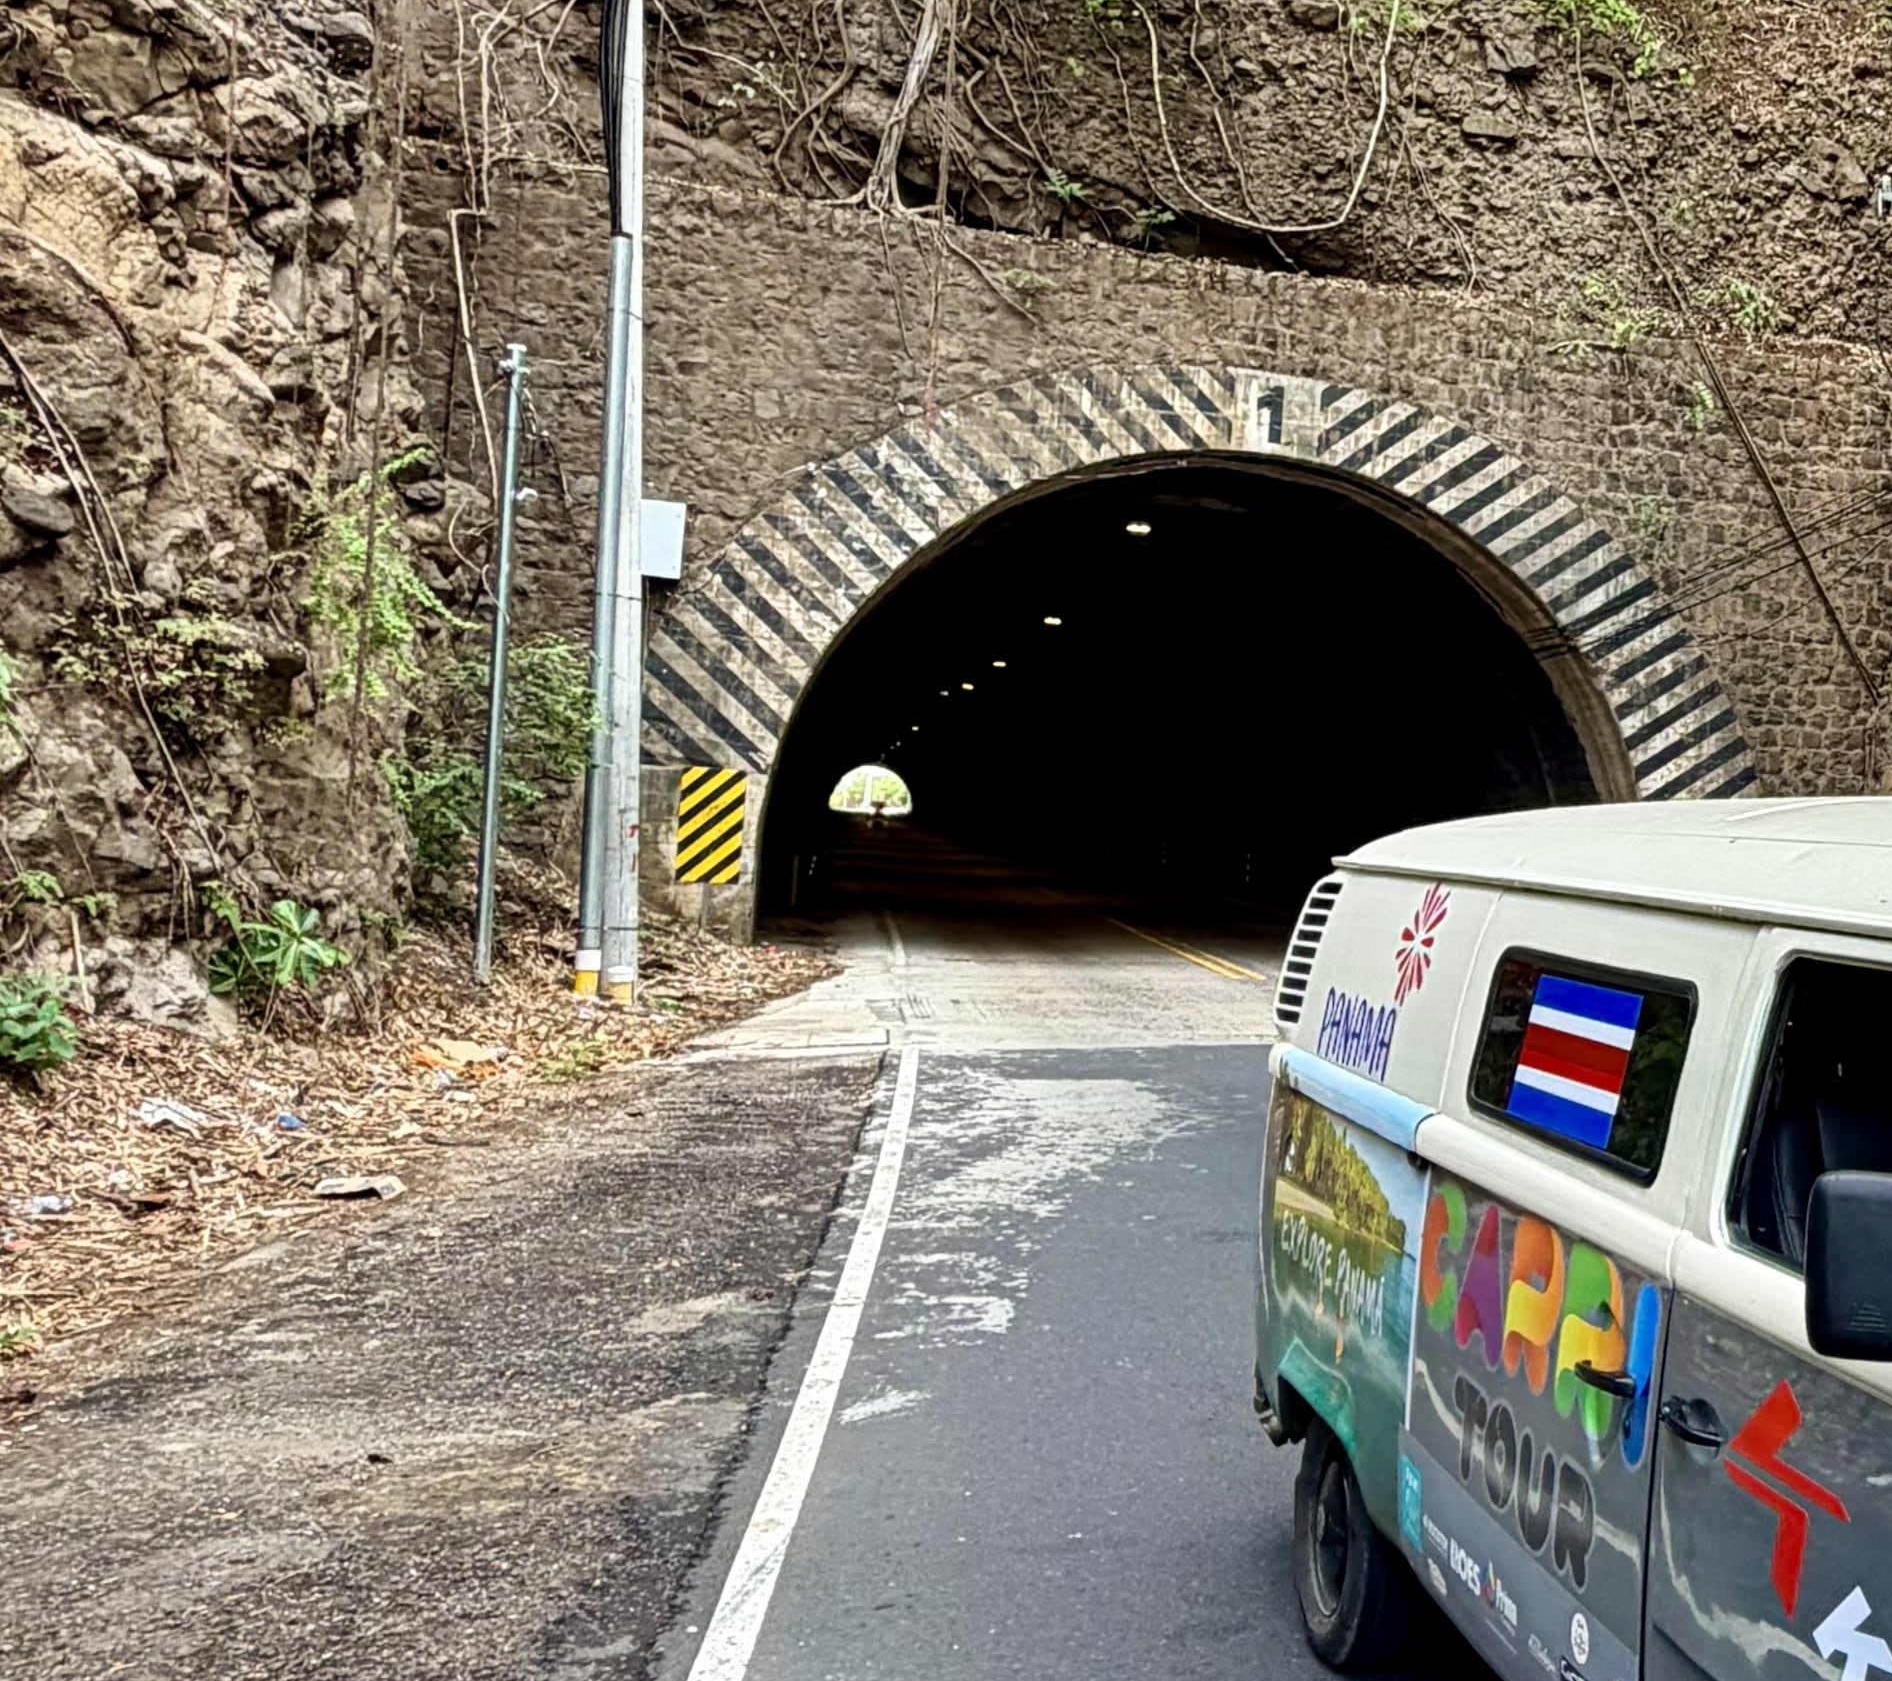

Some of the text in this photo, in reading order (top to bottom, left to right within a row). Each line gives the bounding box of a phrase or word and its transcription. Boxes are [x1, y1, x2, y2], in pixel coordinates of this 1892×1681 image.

[1257, 385, 1285, 444] 1
[1317, 986, 1397, 1083] PANAMA
[1281, 1209, 1333, 1290] EXPLORE
[1453, 1370, 1594, 1594] TOUR
